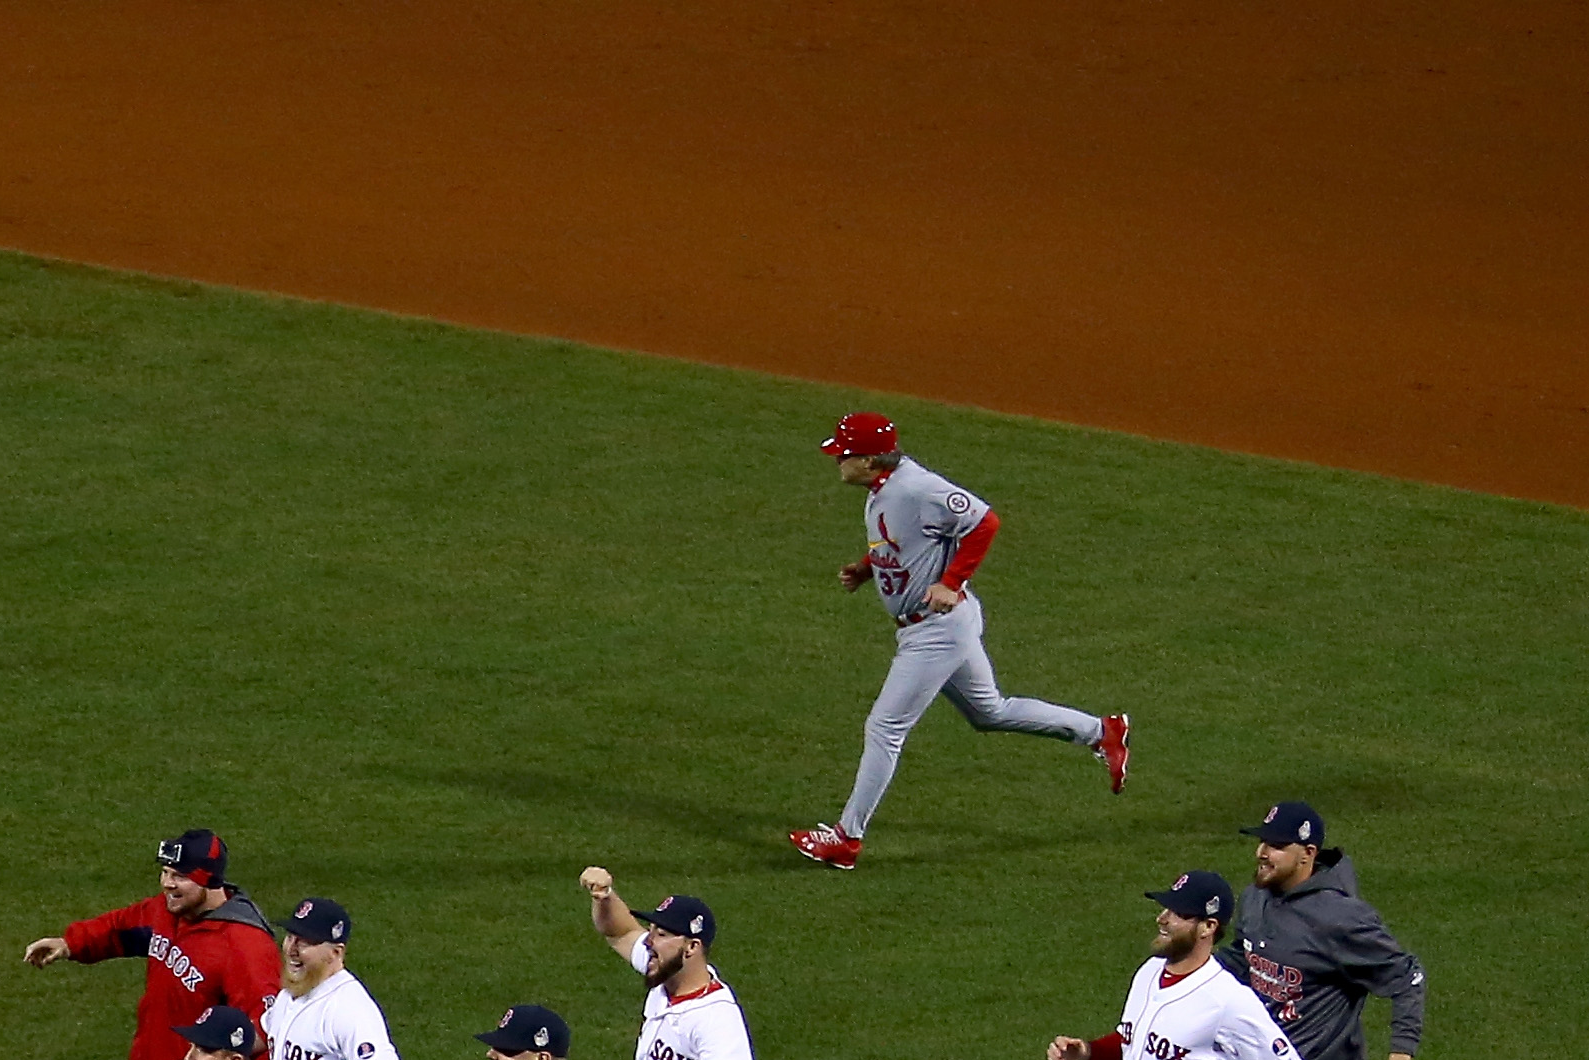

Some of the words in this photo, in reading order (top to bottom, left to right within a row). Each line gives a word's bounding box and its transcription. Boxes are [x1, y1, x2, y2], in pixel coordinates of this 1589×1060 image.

[879, 570, 910, 596] 37
[1172, 874, 1189, 891] B
[295, 901, 314, 919] B
[165, 946, 205, 993] SOX
